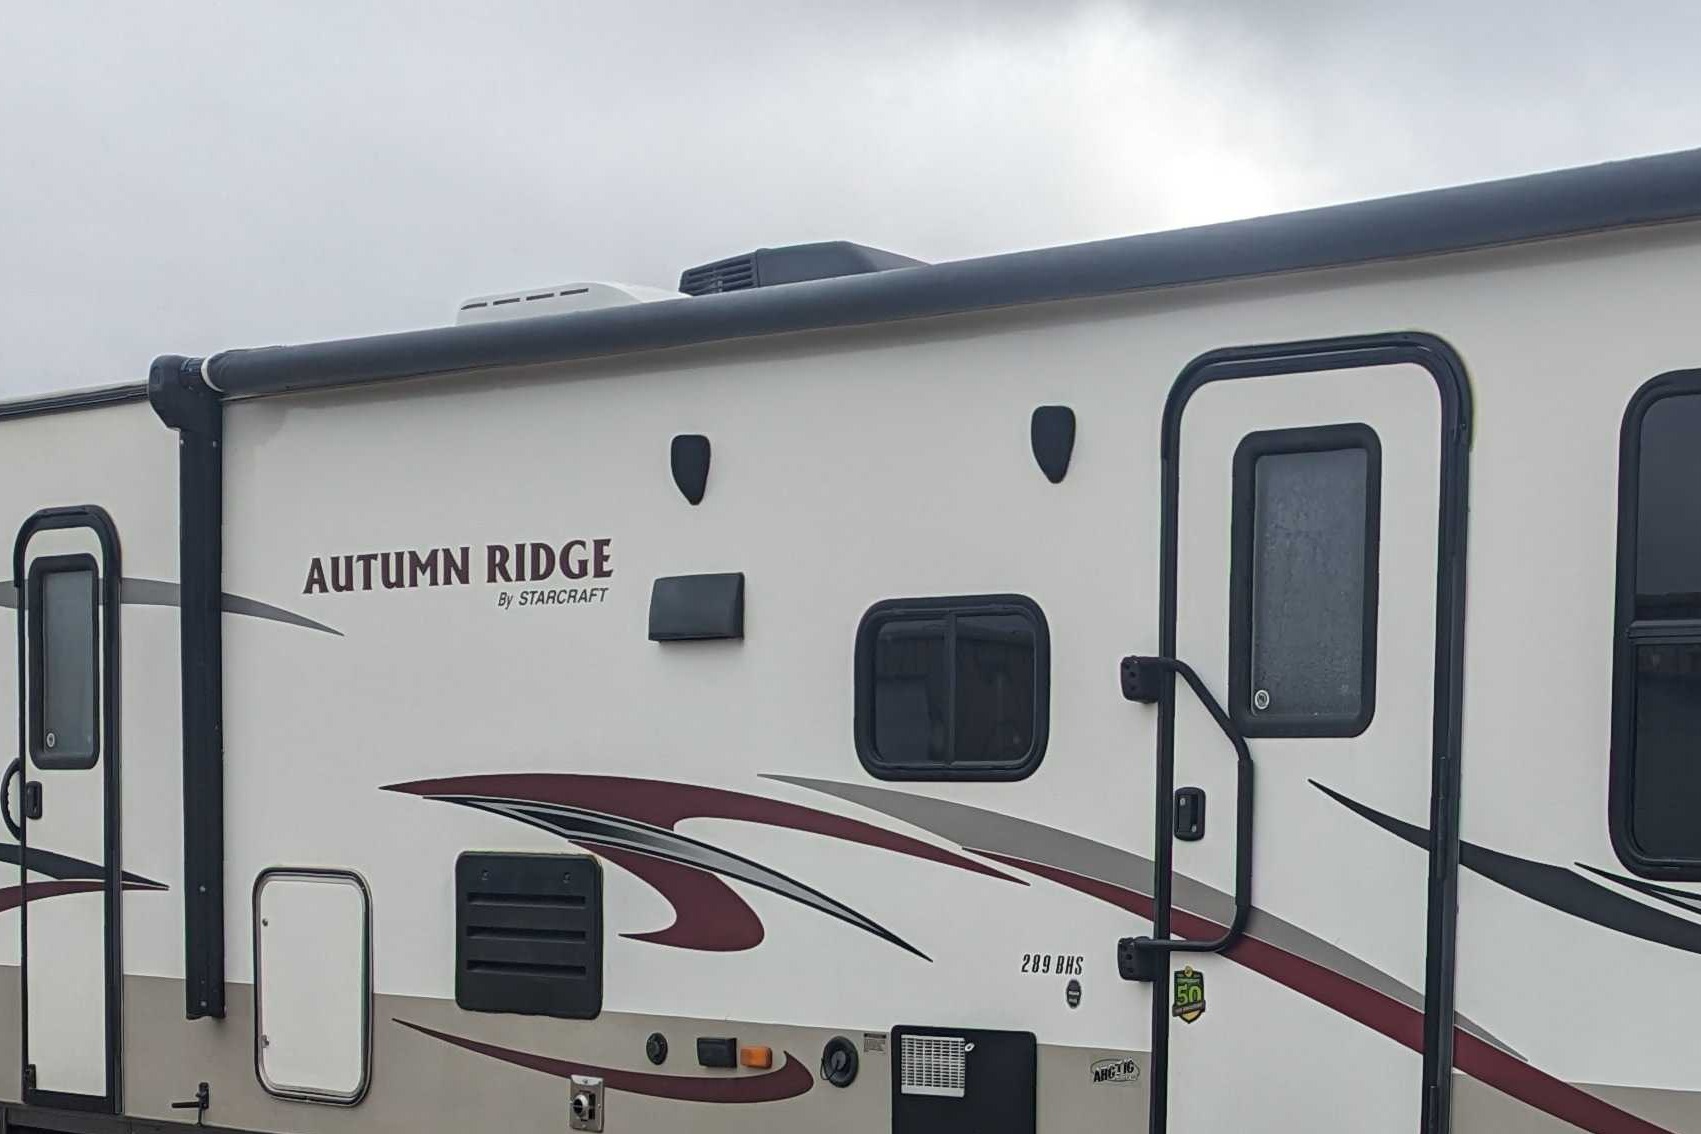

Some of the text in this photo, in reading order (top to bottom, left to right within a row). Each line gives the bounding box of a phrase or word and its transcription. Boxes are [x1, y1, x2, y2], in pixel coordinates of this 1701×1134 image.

[302, 538, 614, 594] AUTUMN RIDGE
[497, 587, 609, 610] By STARCRAFT
[1021, 954, 1083, 975] 289 BHS
[1176, 983, 1202, 1006] 50
